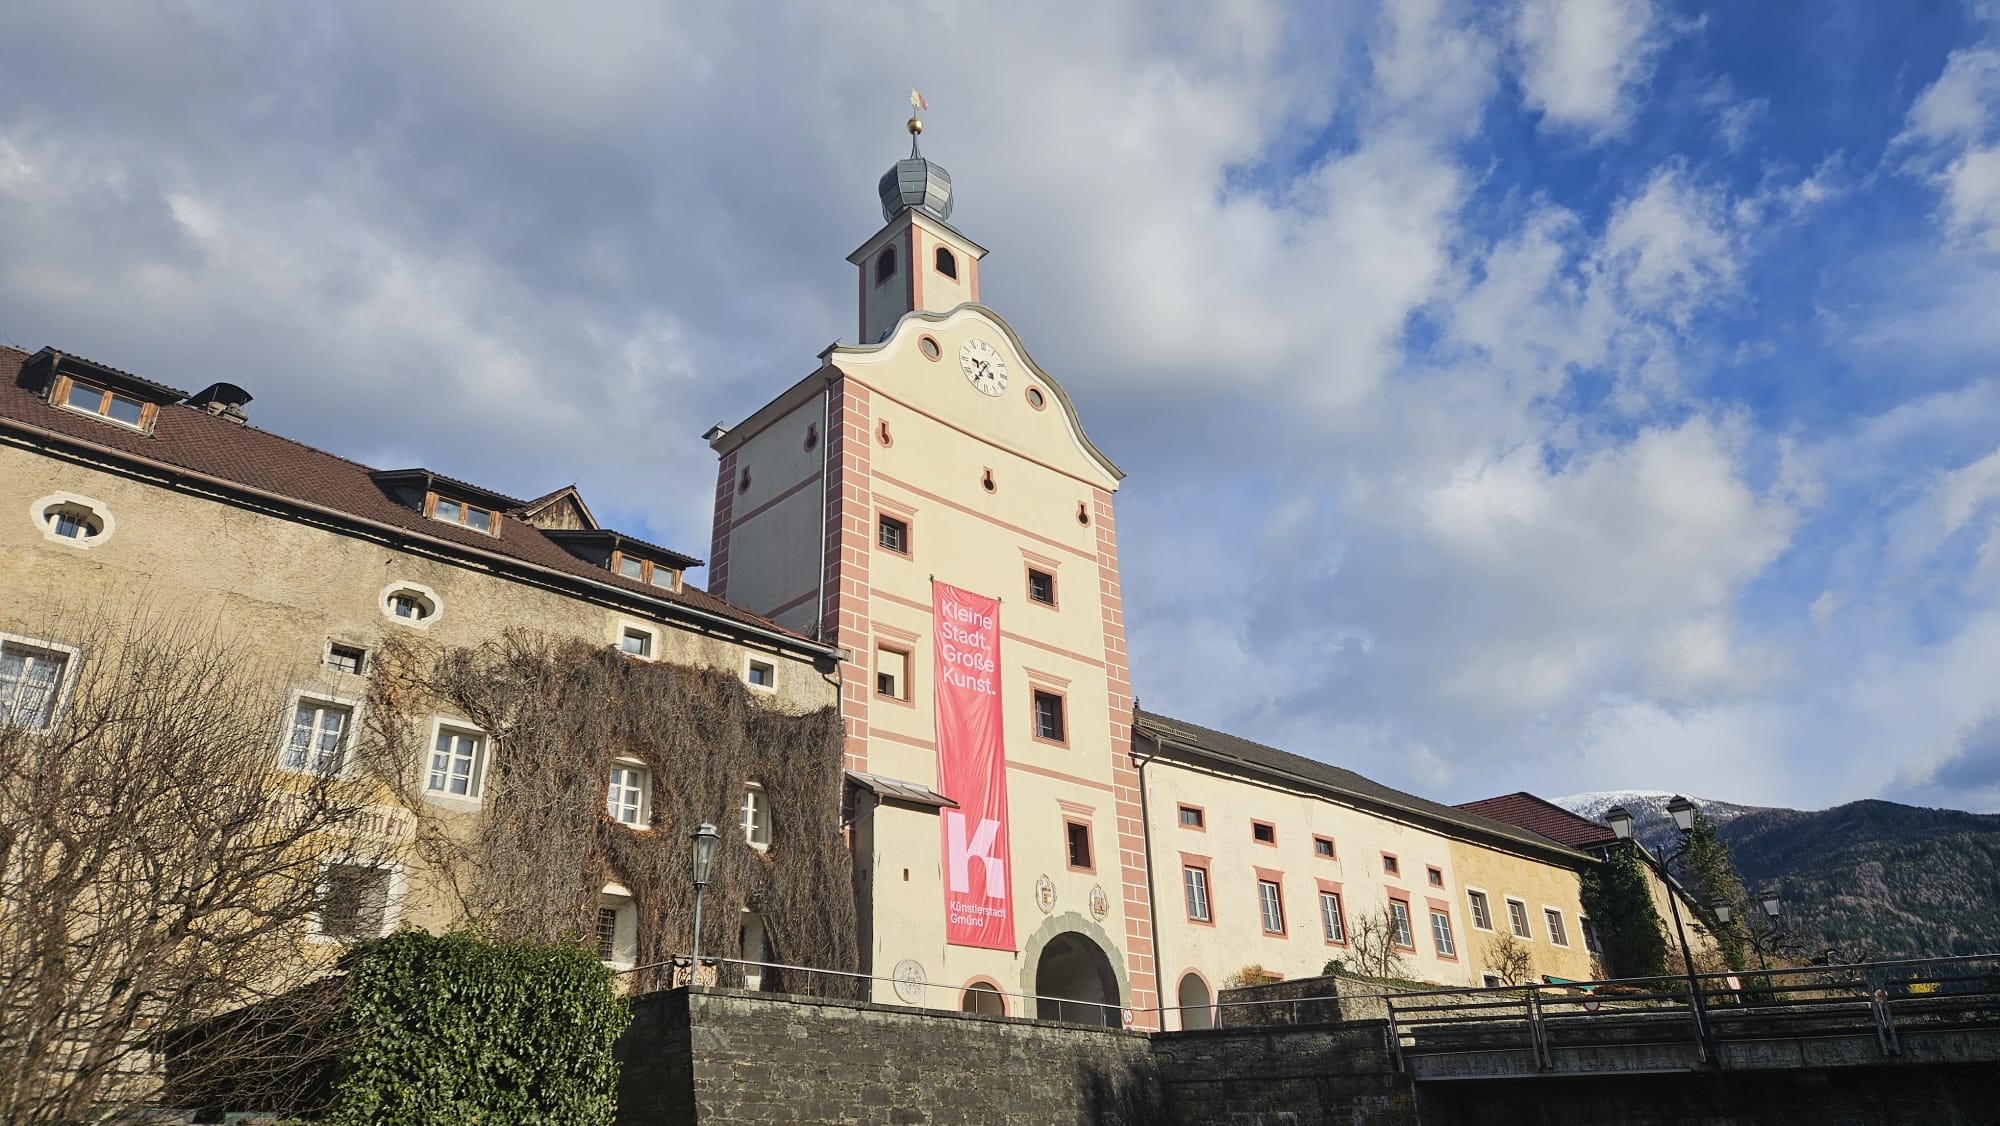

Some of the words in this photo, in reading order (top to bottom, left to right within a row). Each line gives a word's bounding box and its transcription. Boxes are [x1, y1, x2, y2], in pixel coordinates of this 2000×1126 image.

[941, 600, 992, 629] Kleine
[942, 622, 990, 650] Stadt.
[942, 644, 994, 672] Große
[943, 666, 996, 695] Kunst.
[950, 900, 1007, 919] Künstlerstadt
[950, 913, 984, 927] Gmünd
